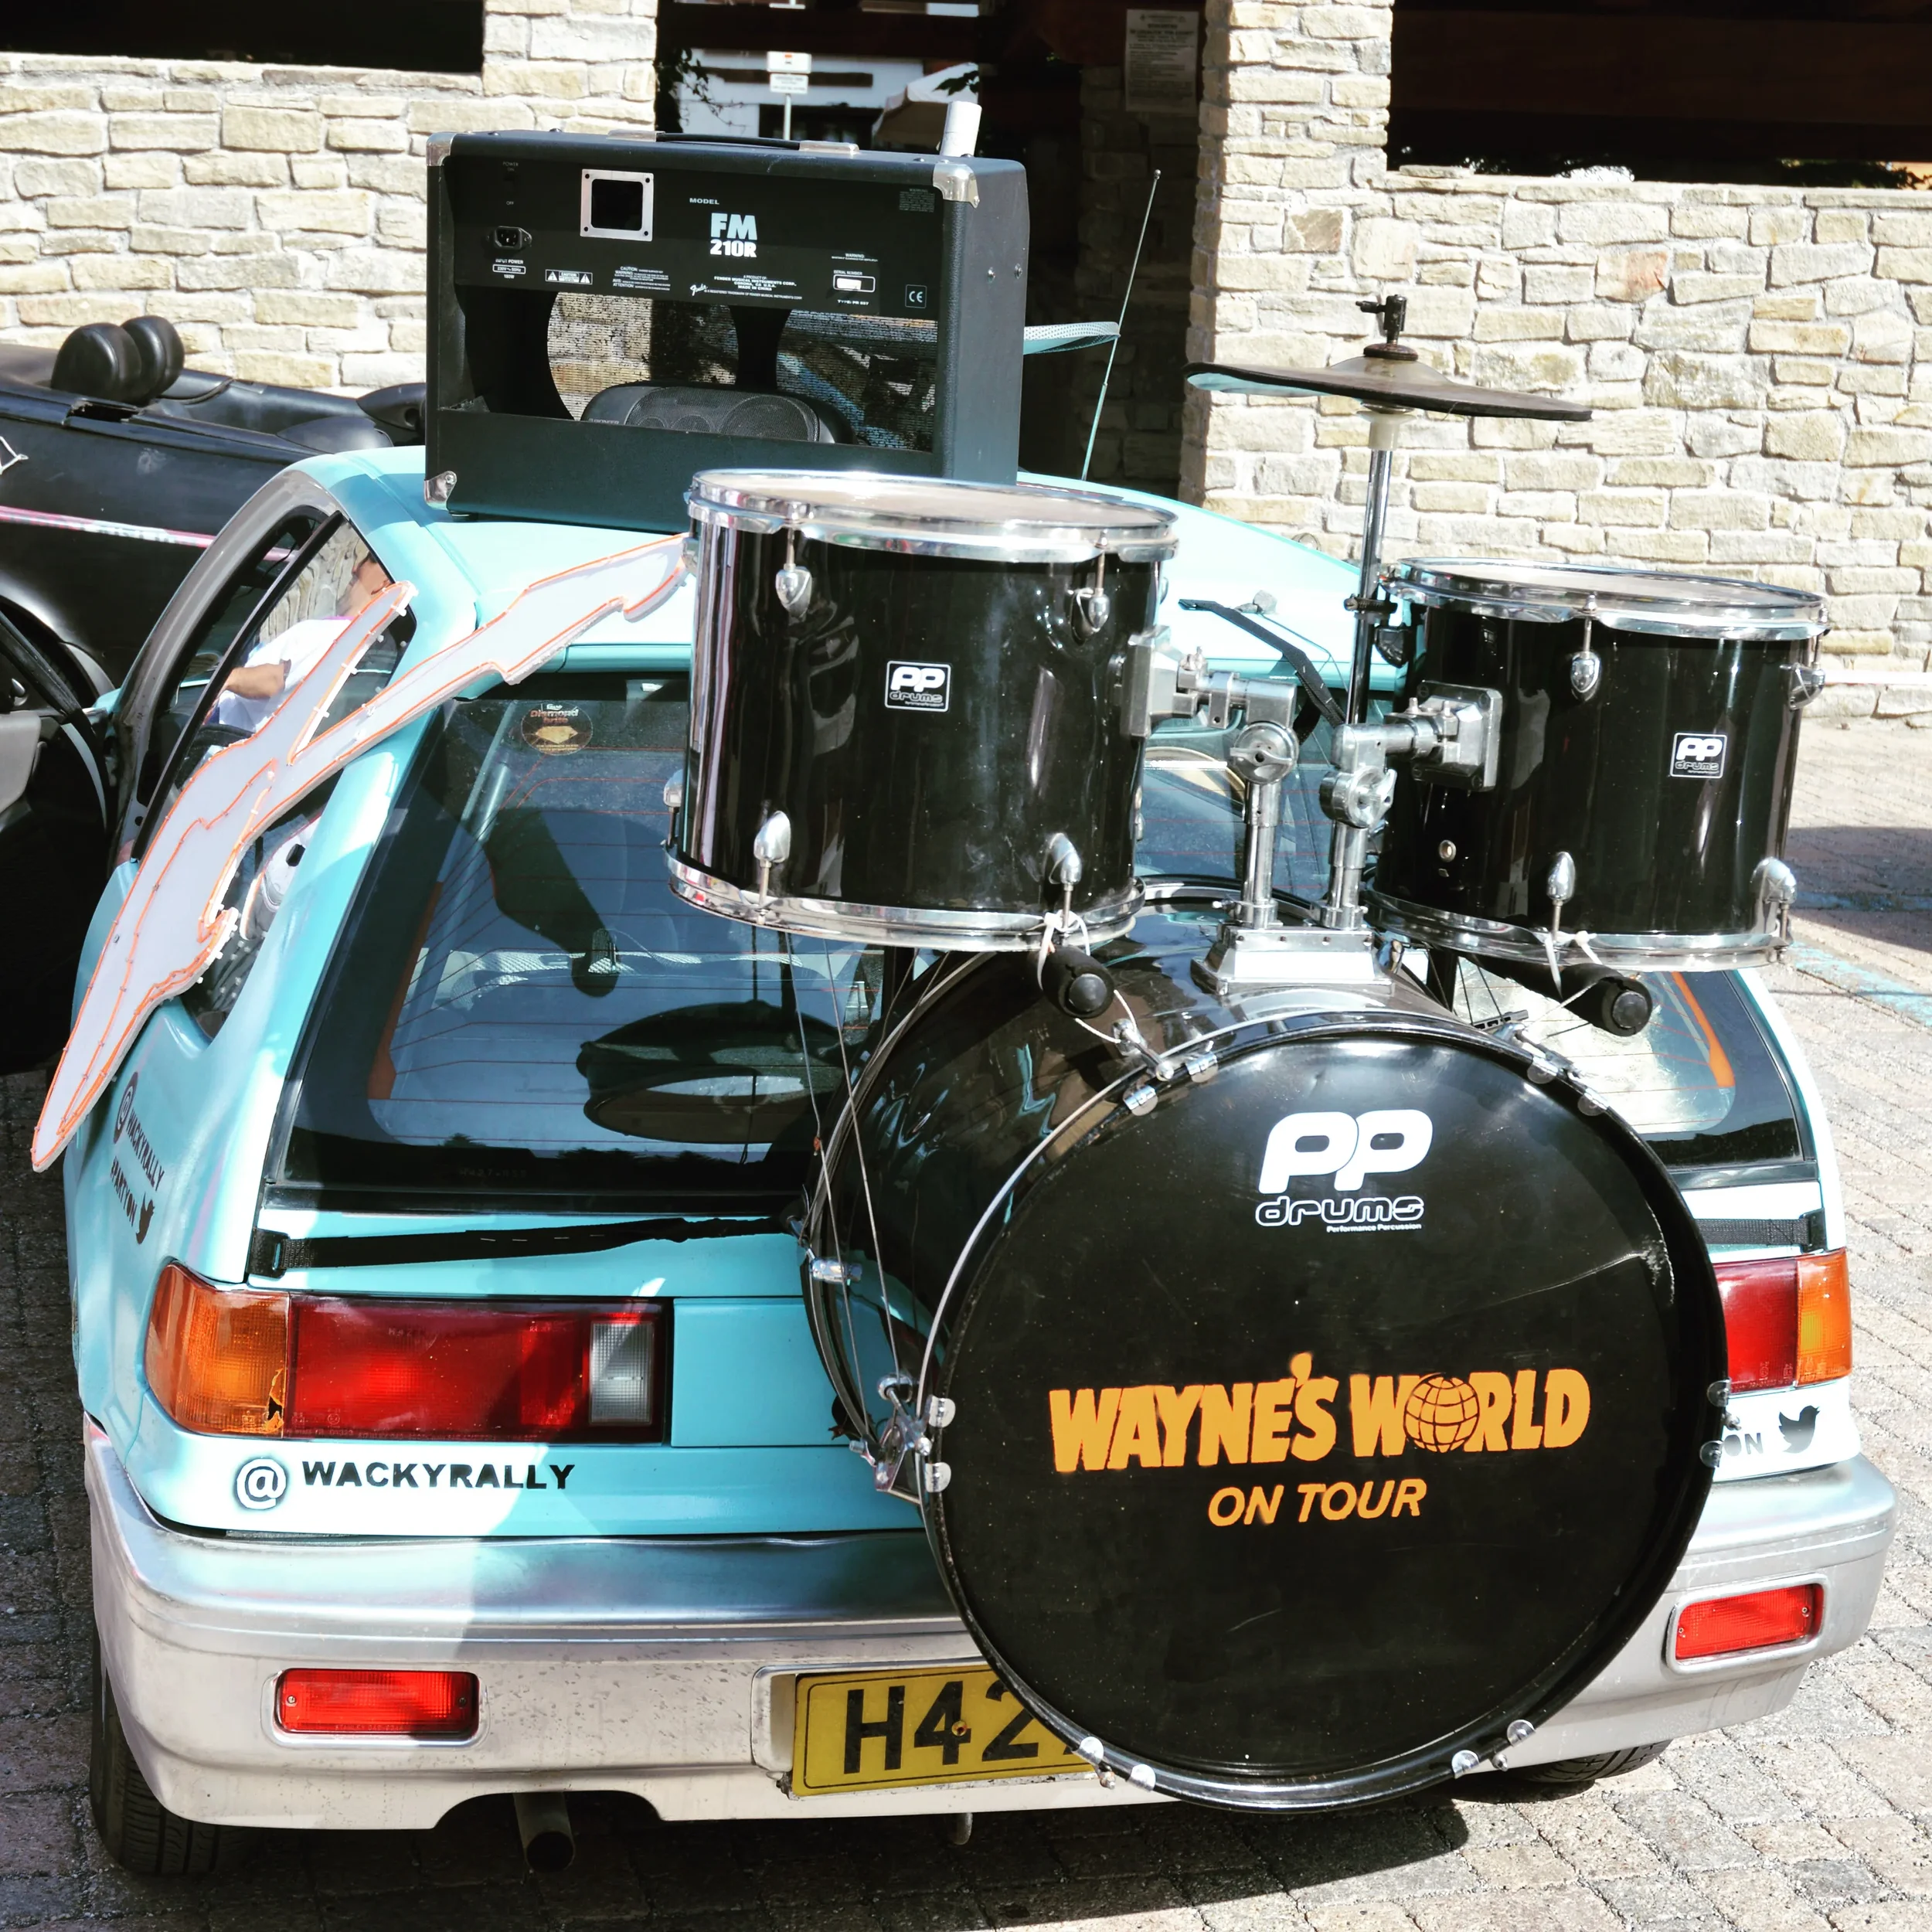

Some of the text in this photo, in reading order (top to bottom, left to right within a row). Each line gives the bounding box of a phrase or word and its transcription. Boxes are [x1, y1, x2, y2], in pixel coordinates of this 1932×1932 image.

[710, 213, 757, 240] FM
[709, 239, 757, 257] 210R
[890, 666, 945, 692] PP
[889, 691, 943, 703] drums
[1676, 737, 1723, 762] PP
[1675, 760, 1719, 771] drums
[1258, 1109, 1433, 1194] PP
[1255, 1196, 1425, 1226] drums
[1326, 1225, 1376, 1233] Performance
[1049, 1353, 1338, 1473] WAYNE'S
[302, 1461, 576, 1491] WACKYRALLY
[1208, 1478, 1427, 1527] ON TOUR
[844, 1679, 1073, 1775] H42
